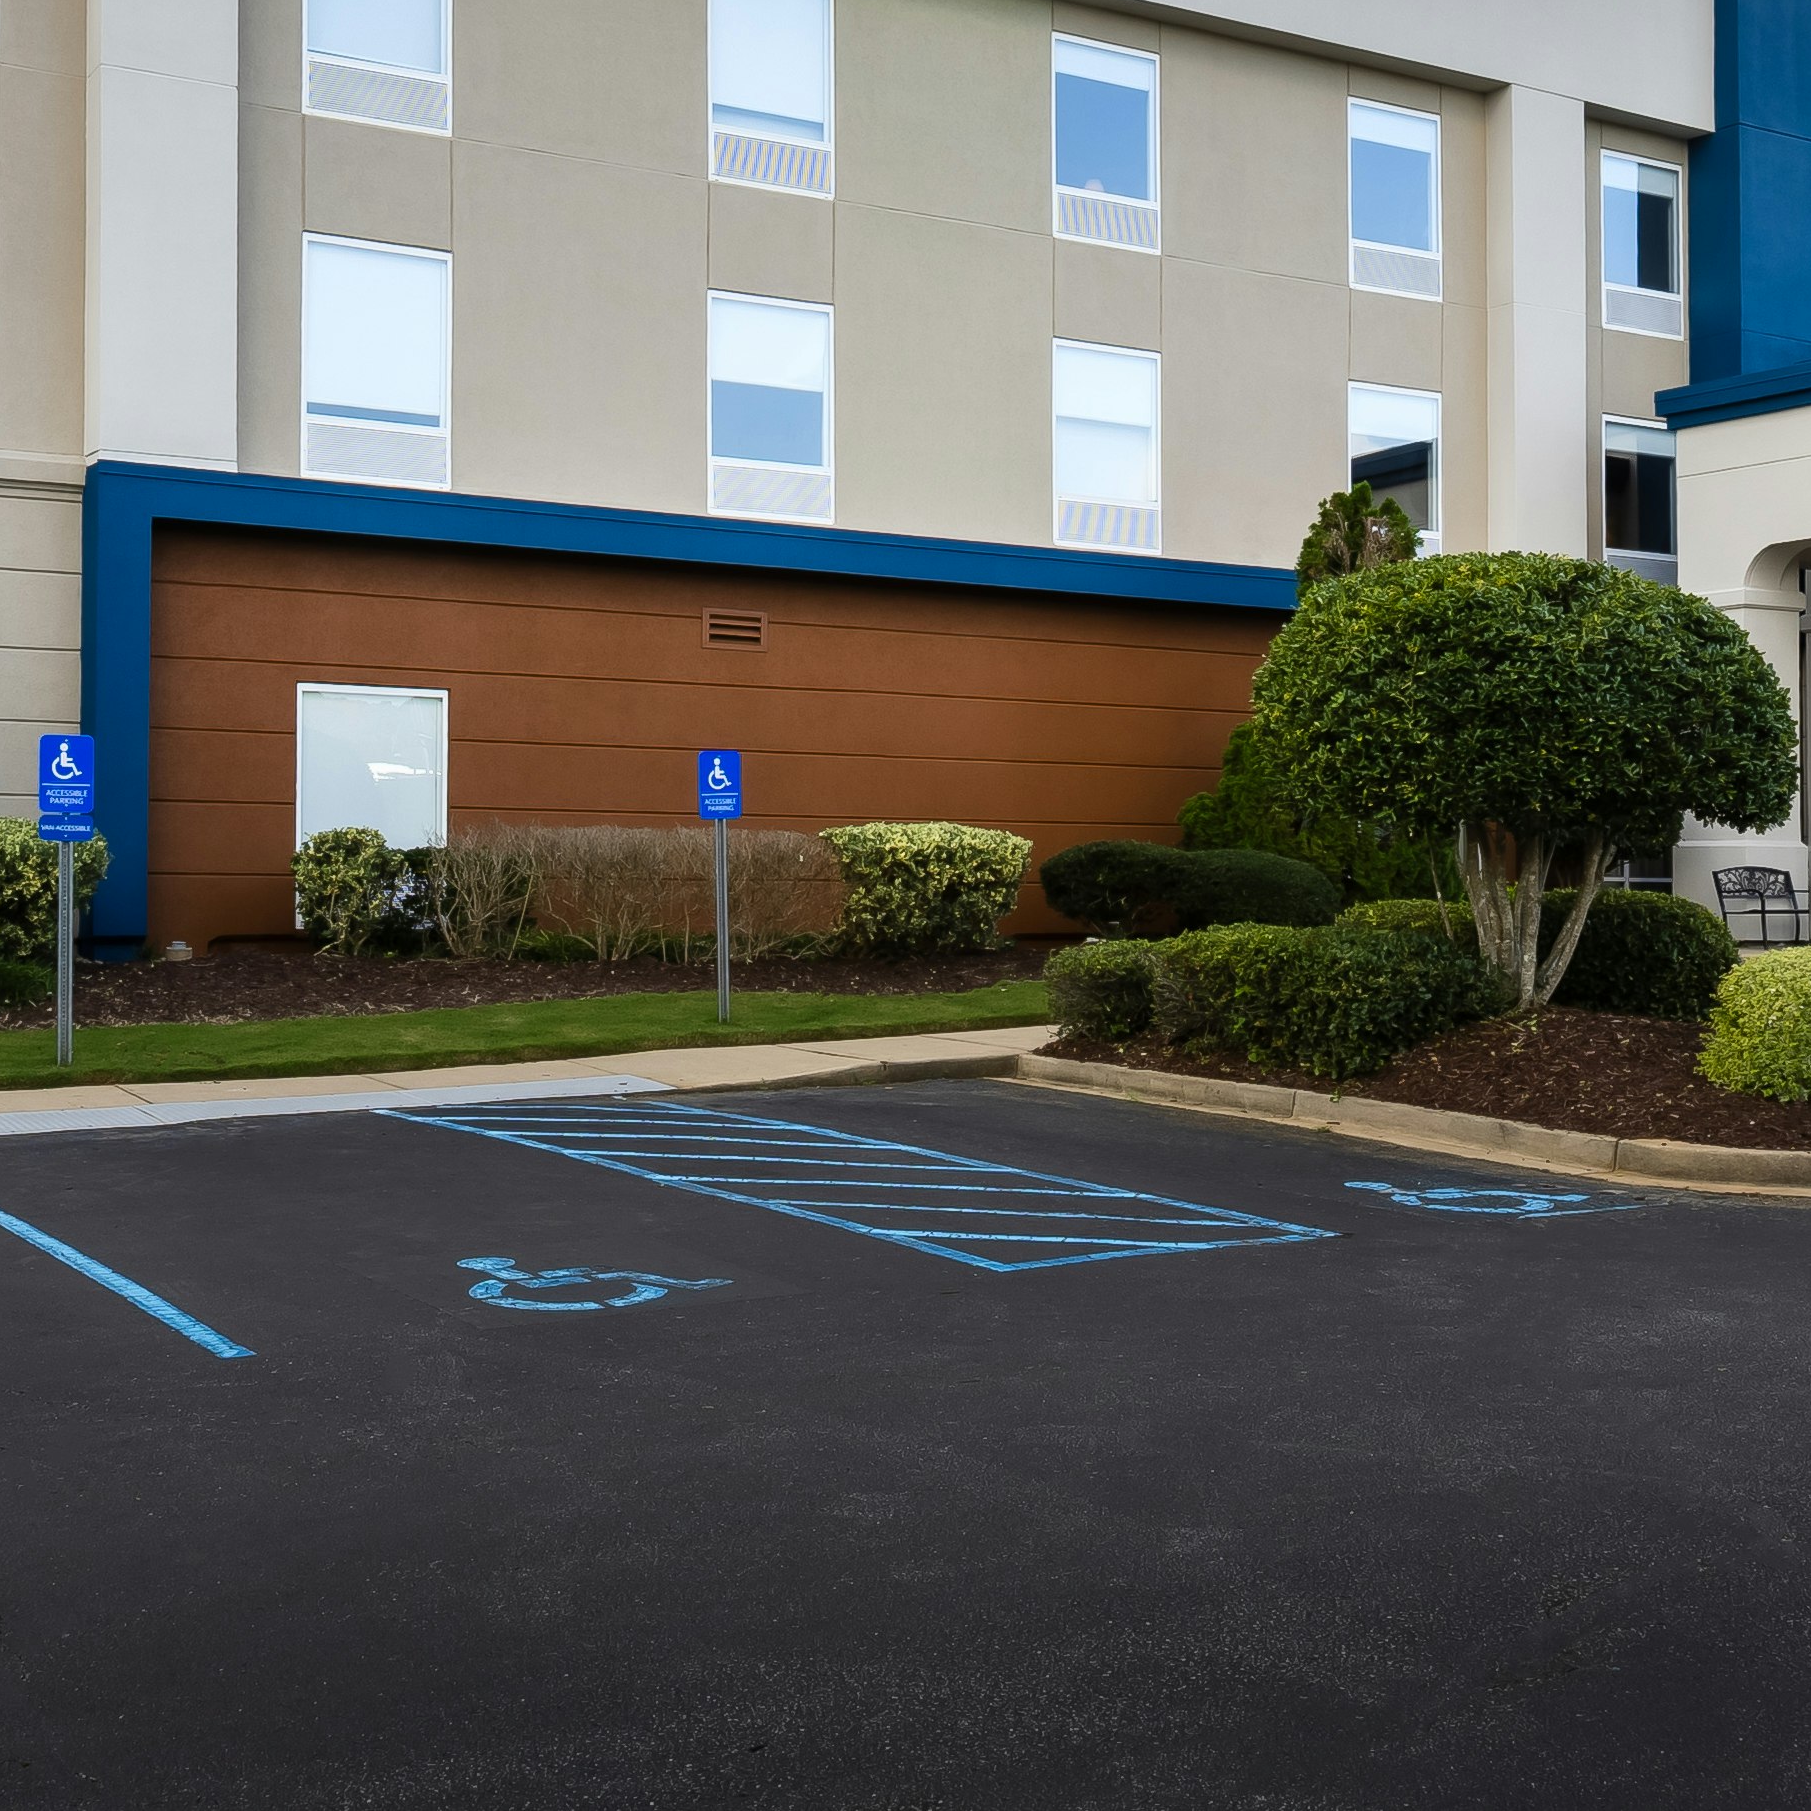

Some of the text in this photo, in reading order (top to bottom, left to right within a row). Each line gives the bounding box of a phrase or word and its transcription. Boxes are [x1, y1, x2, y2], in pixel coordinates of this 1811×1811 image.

[45, 789, 89, 798] ACCESSIBLE
[49, 797, 84, 805] PARKING
[704, 797, 737, 805] ACCESSIBLE
